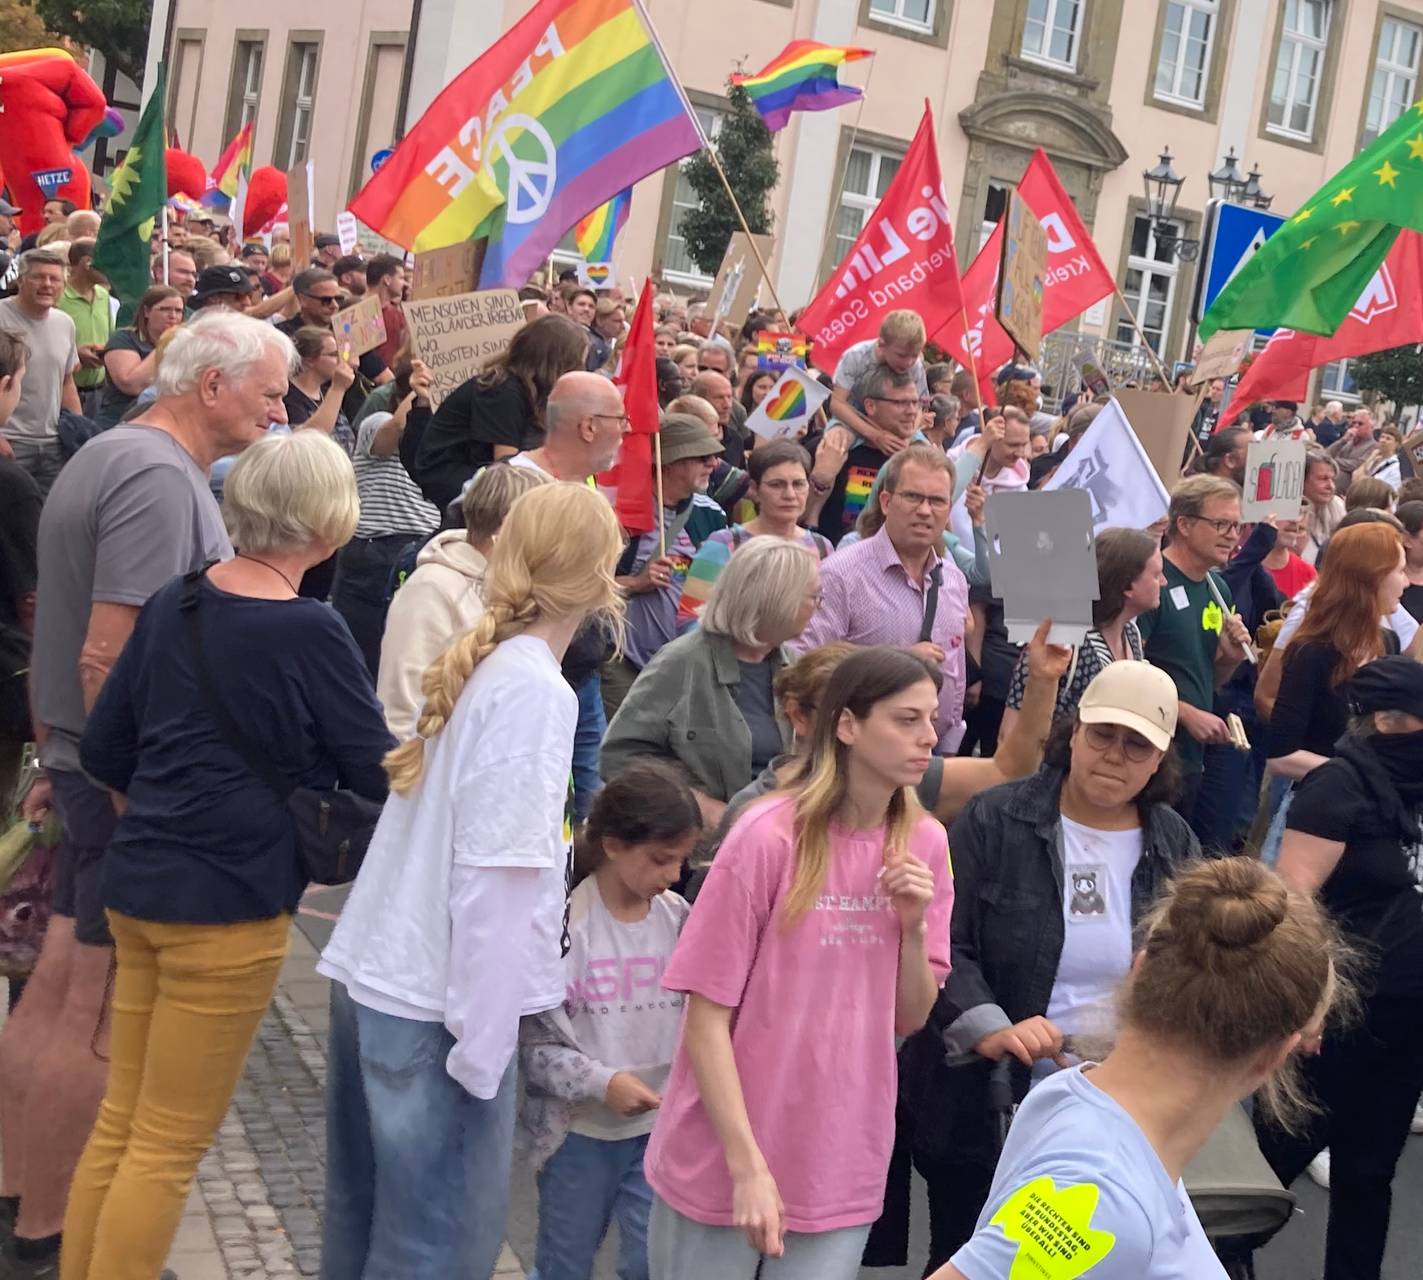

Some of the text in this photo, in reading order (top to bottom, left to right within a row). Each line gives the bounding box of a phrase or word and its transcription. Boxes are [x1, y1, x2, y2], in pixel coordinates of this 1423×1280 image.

[37, 171, 71, 187] HETZE
[410, 294, 515, 324] MENSCHEN SIND
[421, 342, 480, 369] RASSISTEN
[1019, 1209, 1073, 1261] ABER WIR SIND
[1020, 1222, 1058, 1258] ÜBERALL!
[1025, 1201, 1036, 1212] IM
[1034, 1210, 1079, 1257] BUNDESTAG,
[1029, 1192, 1092, 1252] DIE RECHTEN SIND
